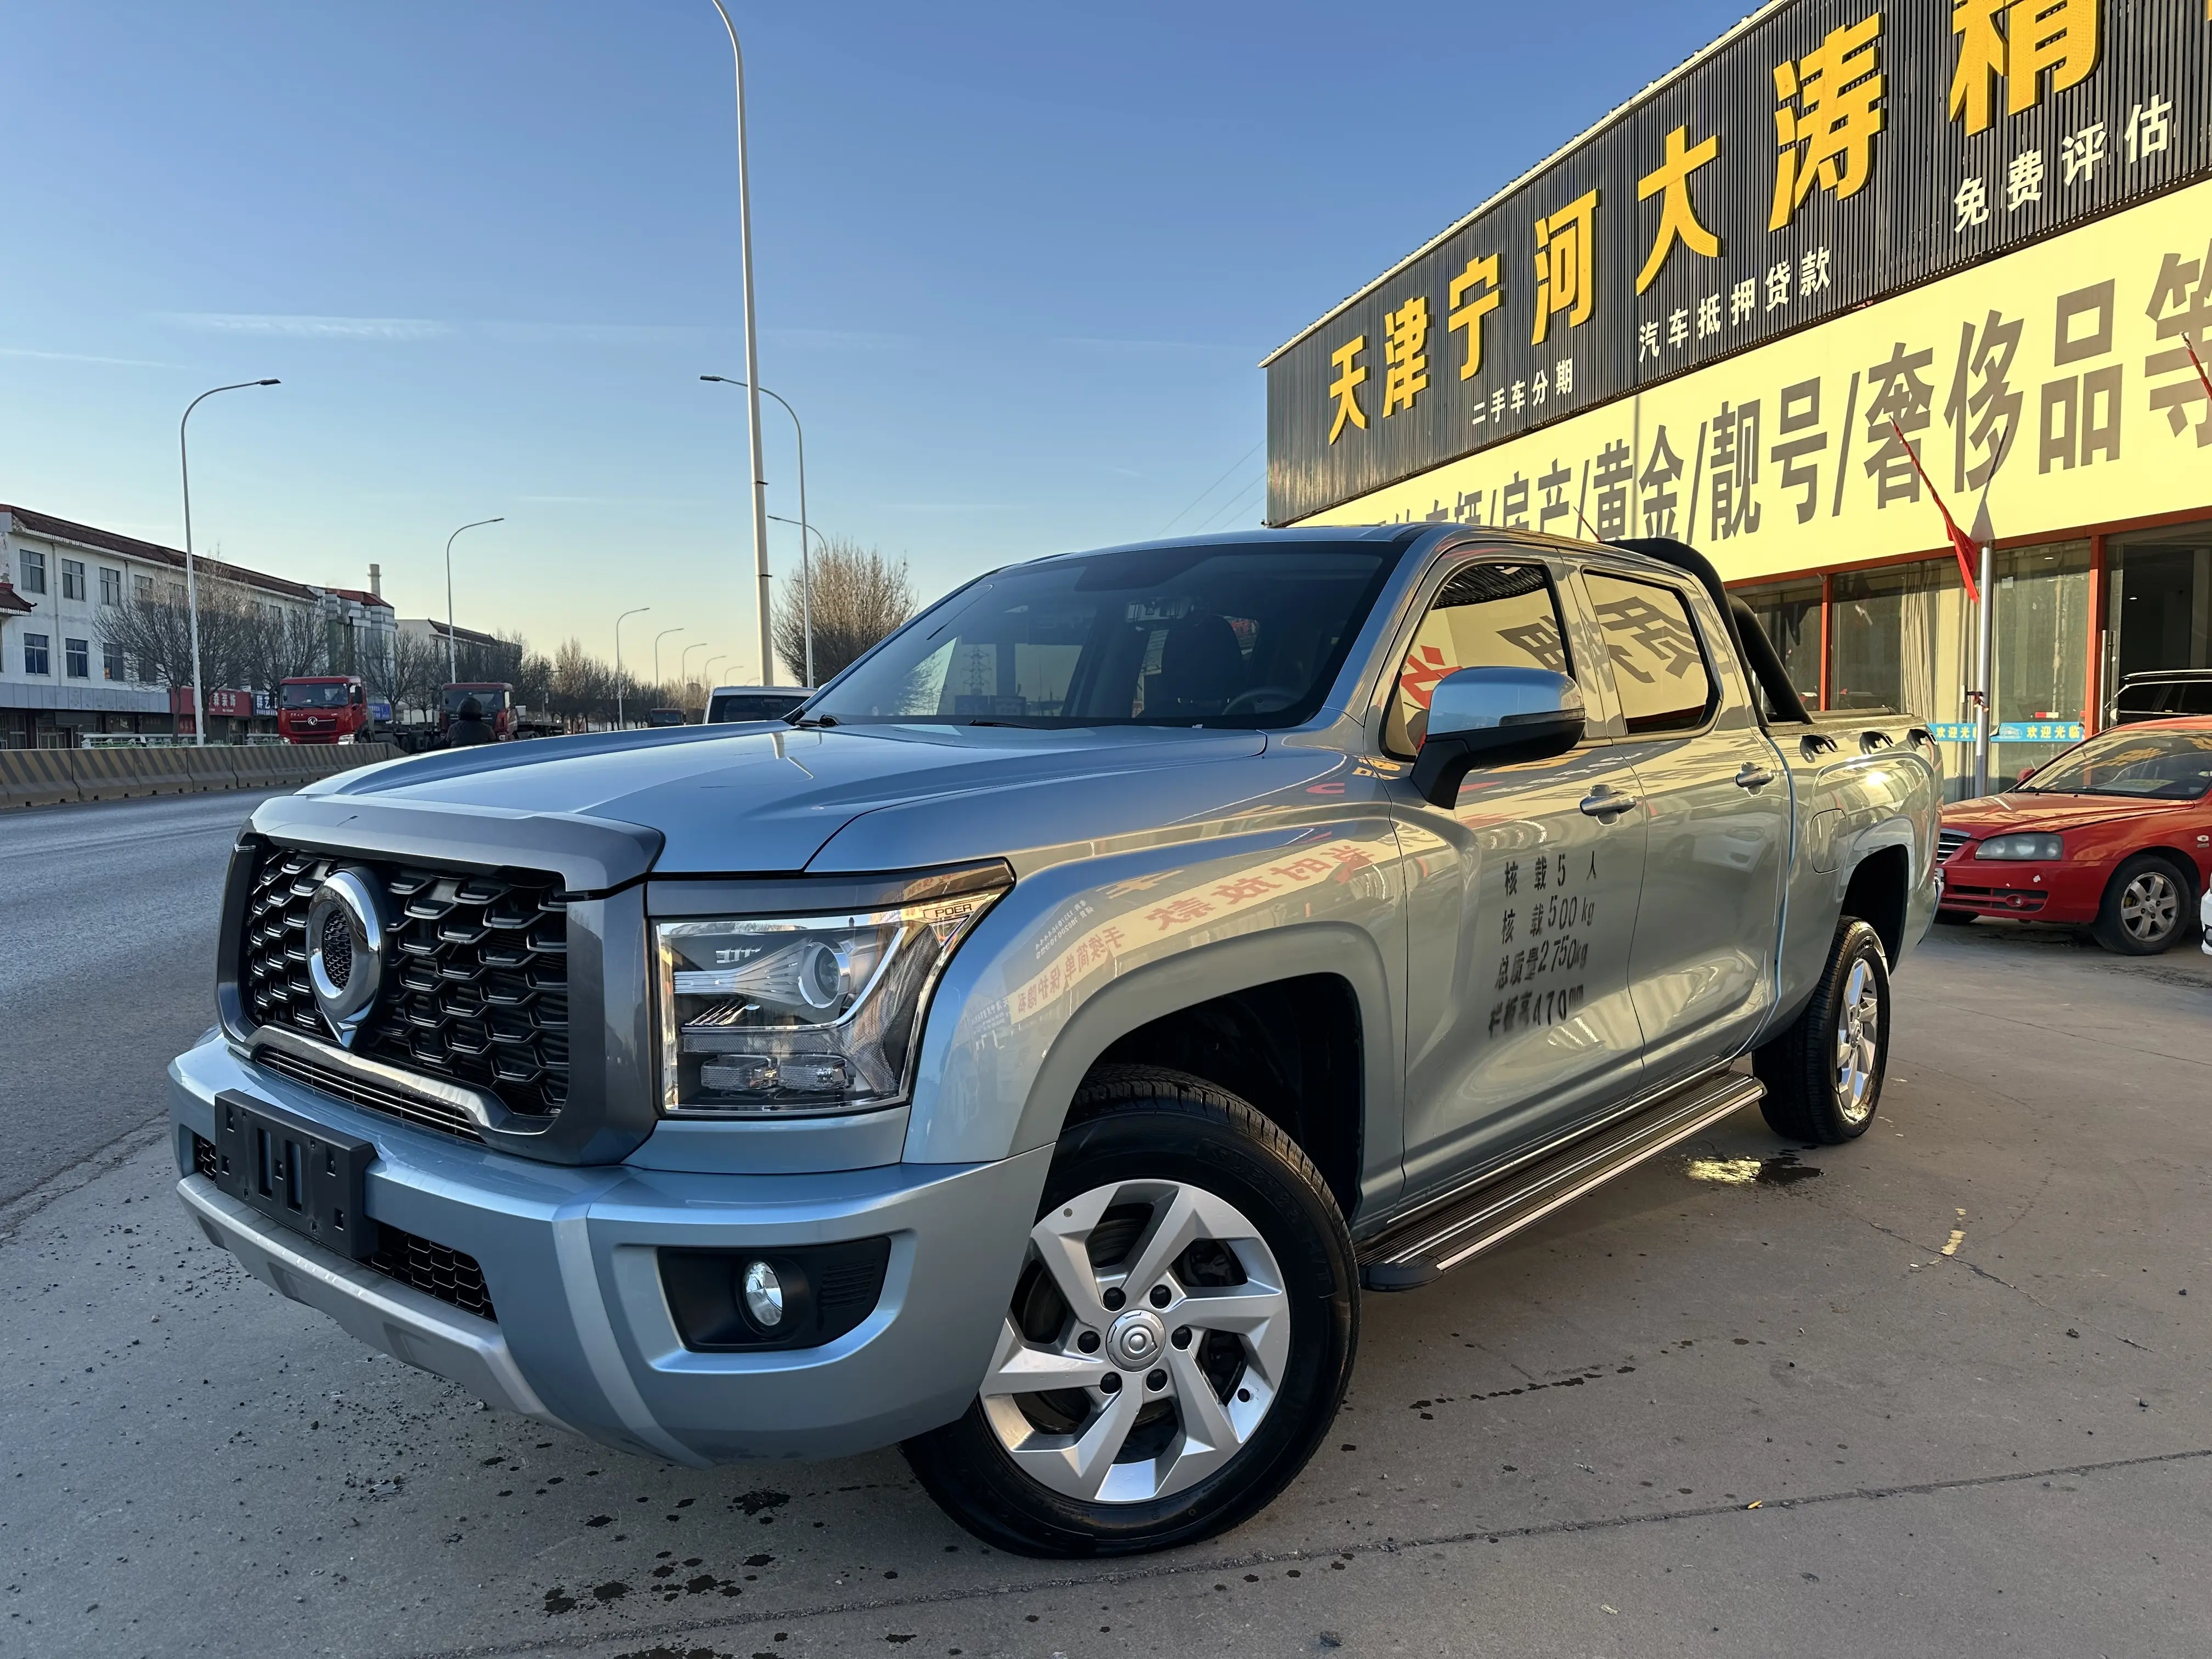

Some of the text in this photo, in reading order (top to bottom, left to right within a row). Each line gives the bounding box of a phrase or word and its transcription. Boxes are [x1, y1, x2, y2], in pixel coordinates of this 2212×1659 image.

[1473, 94, 2175, 426] 二手车分期 汽车抵押贷款 免费评估
[1936, 726, 1977, 738] 欢迎光
[2027, 725, 2080, 738] 欢迎光临
[935, 904, 972, 918] POER
